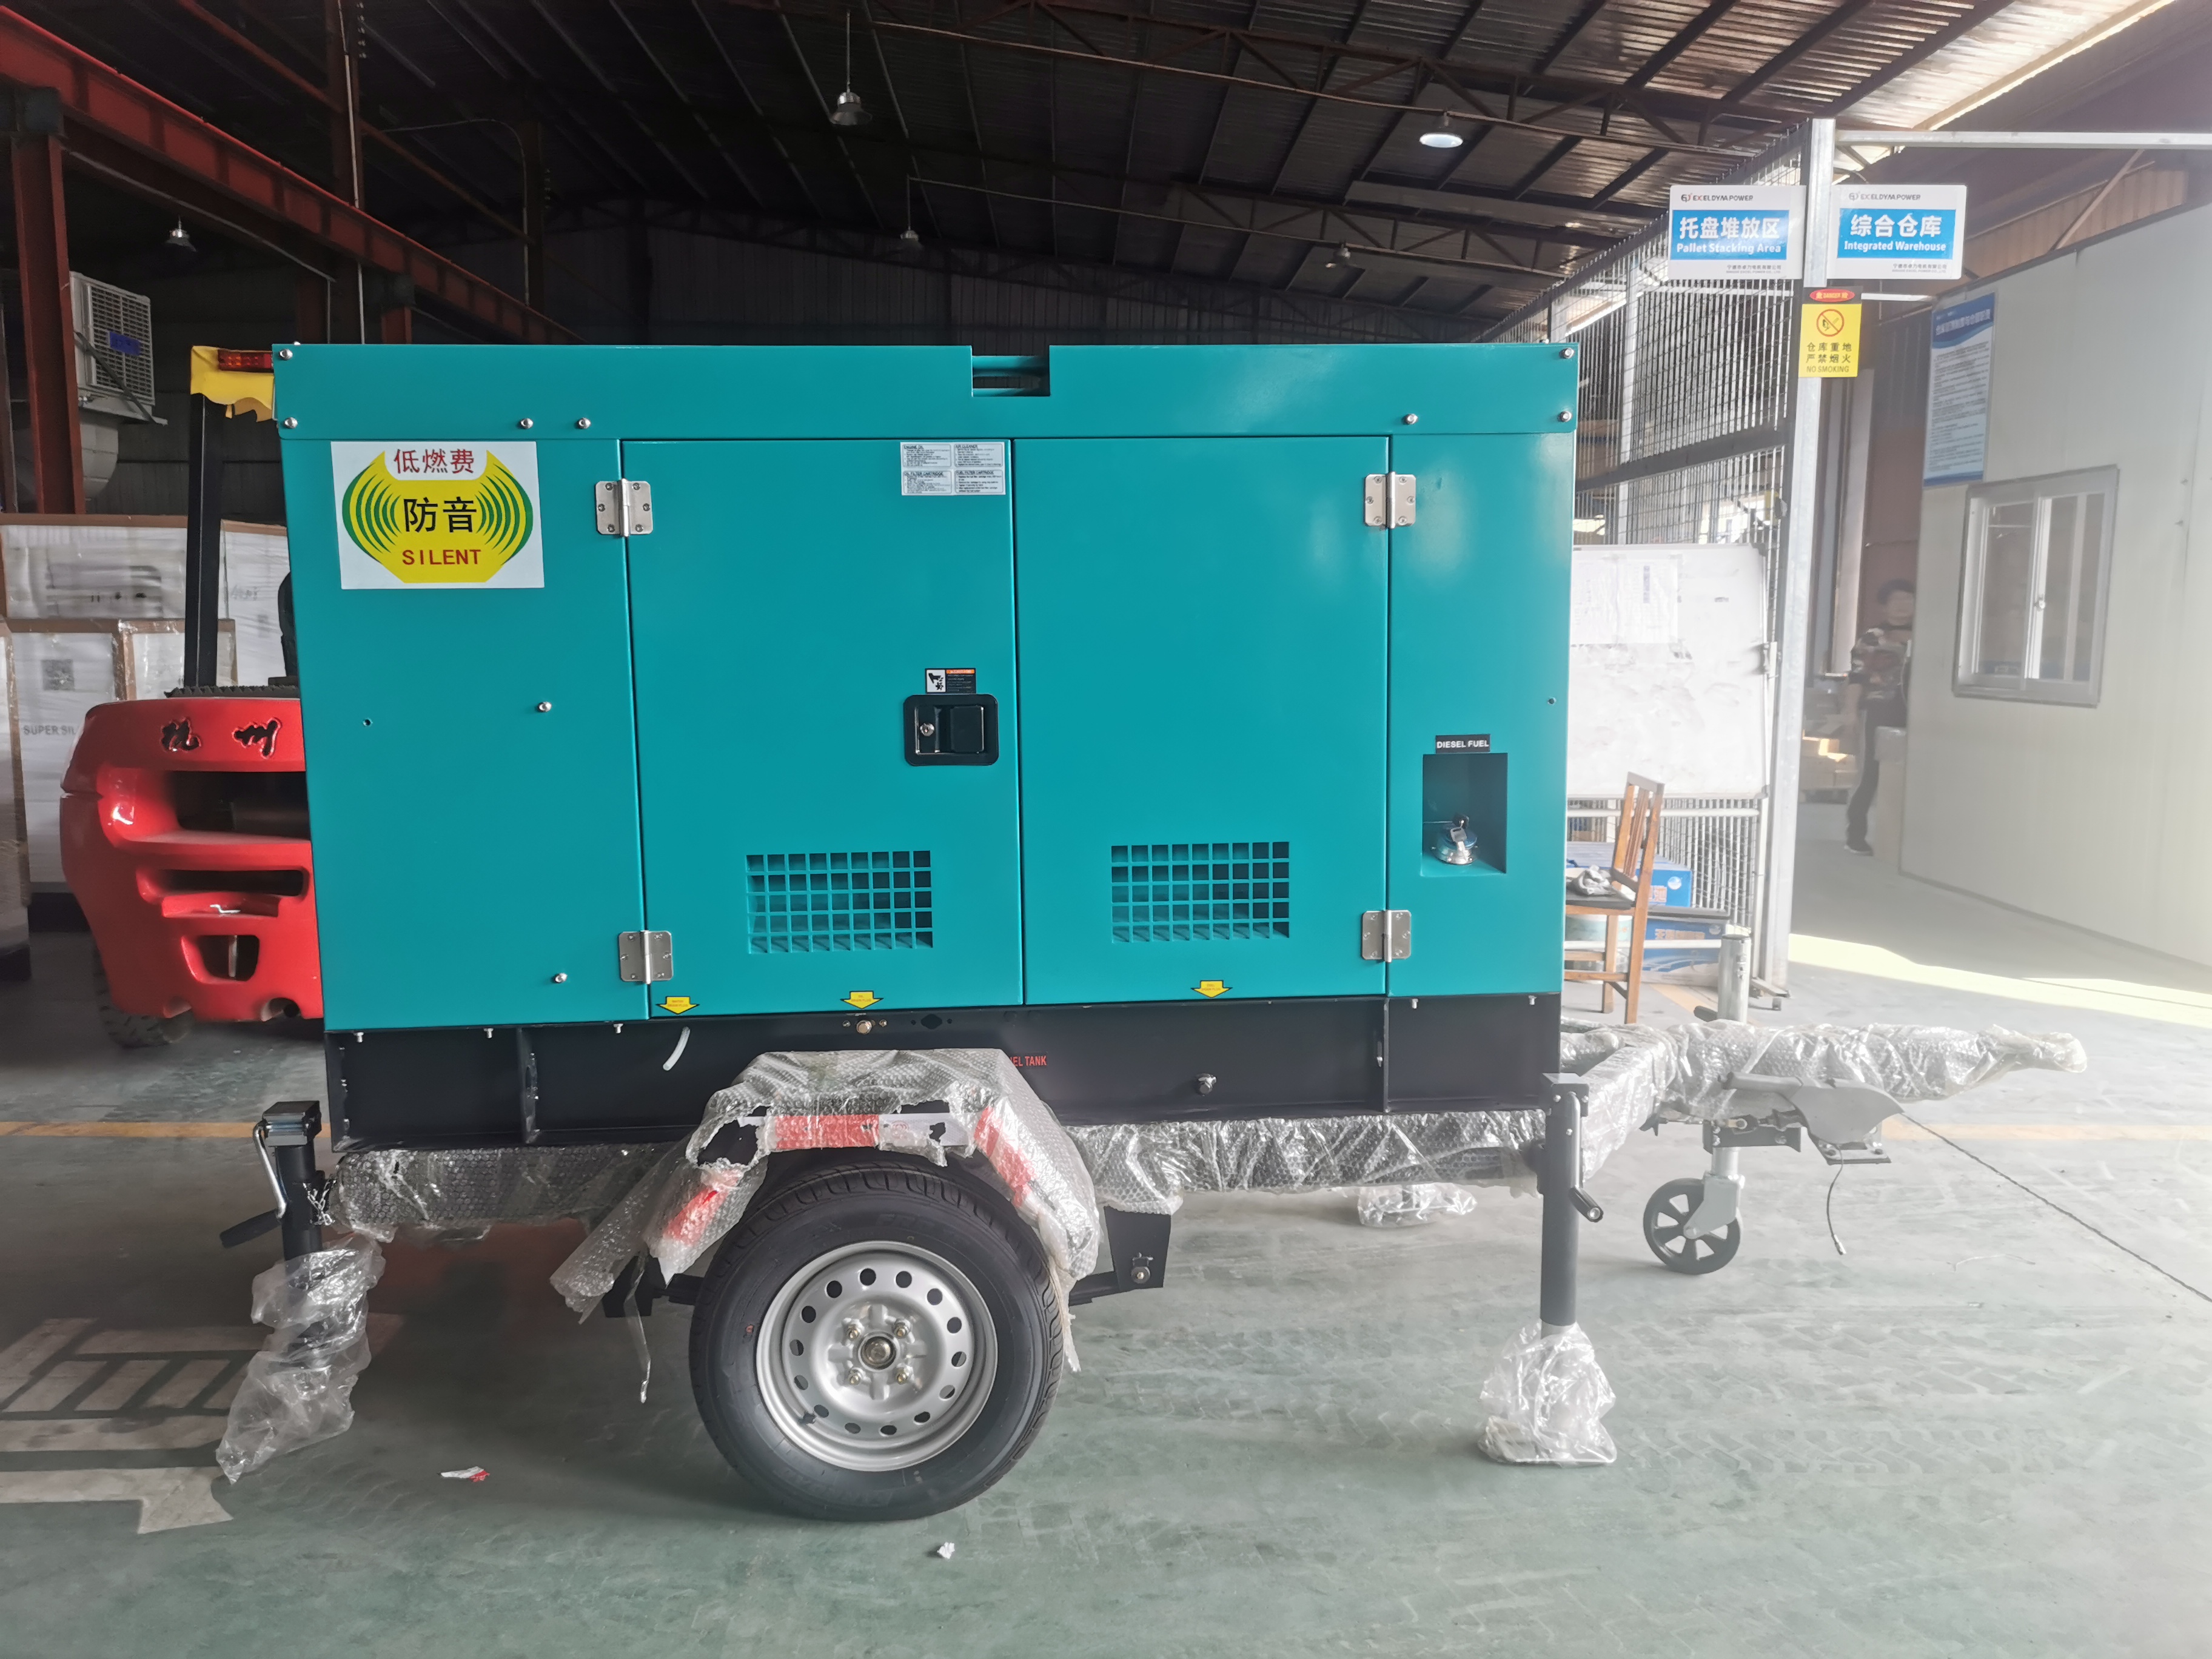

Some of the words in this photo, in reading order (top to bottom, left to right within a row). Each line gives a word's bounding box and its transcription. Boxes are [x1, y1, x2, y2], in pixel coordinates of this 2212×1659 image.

[1679, 216, 1780, 240] 托盘堆放区
[1850, 213, 1942, 238] 综合仓库
[1677, 243, 1707, 252] Pallet
[1709, 243, 1754, 255] Stacking
[1757, 244, 1781, 252] Area
[1844, 241, 1893, 252] Integrated
[1895, 241, 1946, 251] Warehouse
[1807, 342, 1852, 352] 仓库重地
[1806, 354, 1851, 363] 严禁烟火
[394, 449, 474, 474] 低燃费
[403, 497, 477, 533] 防音
[402, 549, 481, 565] SILENT
[23, 725, 59, 735] SUPER
[1436, 740, 1466, 749] DIESEL
[1010, 1056, 1023, 1067] EL
[1025, 1055, 1047, 1066] TANK
